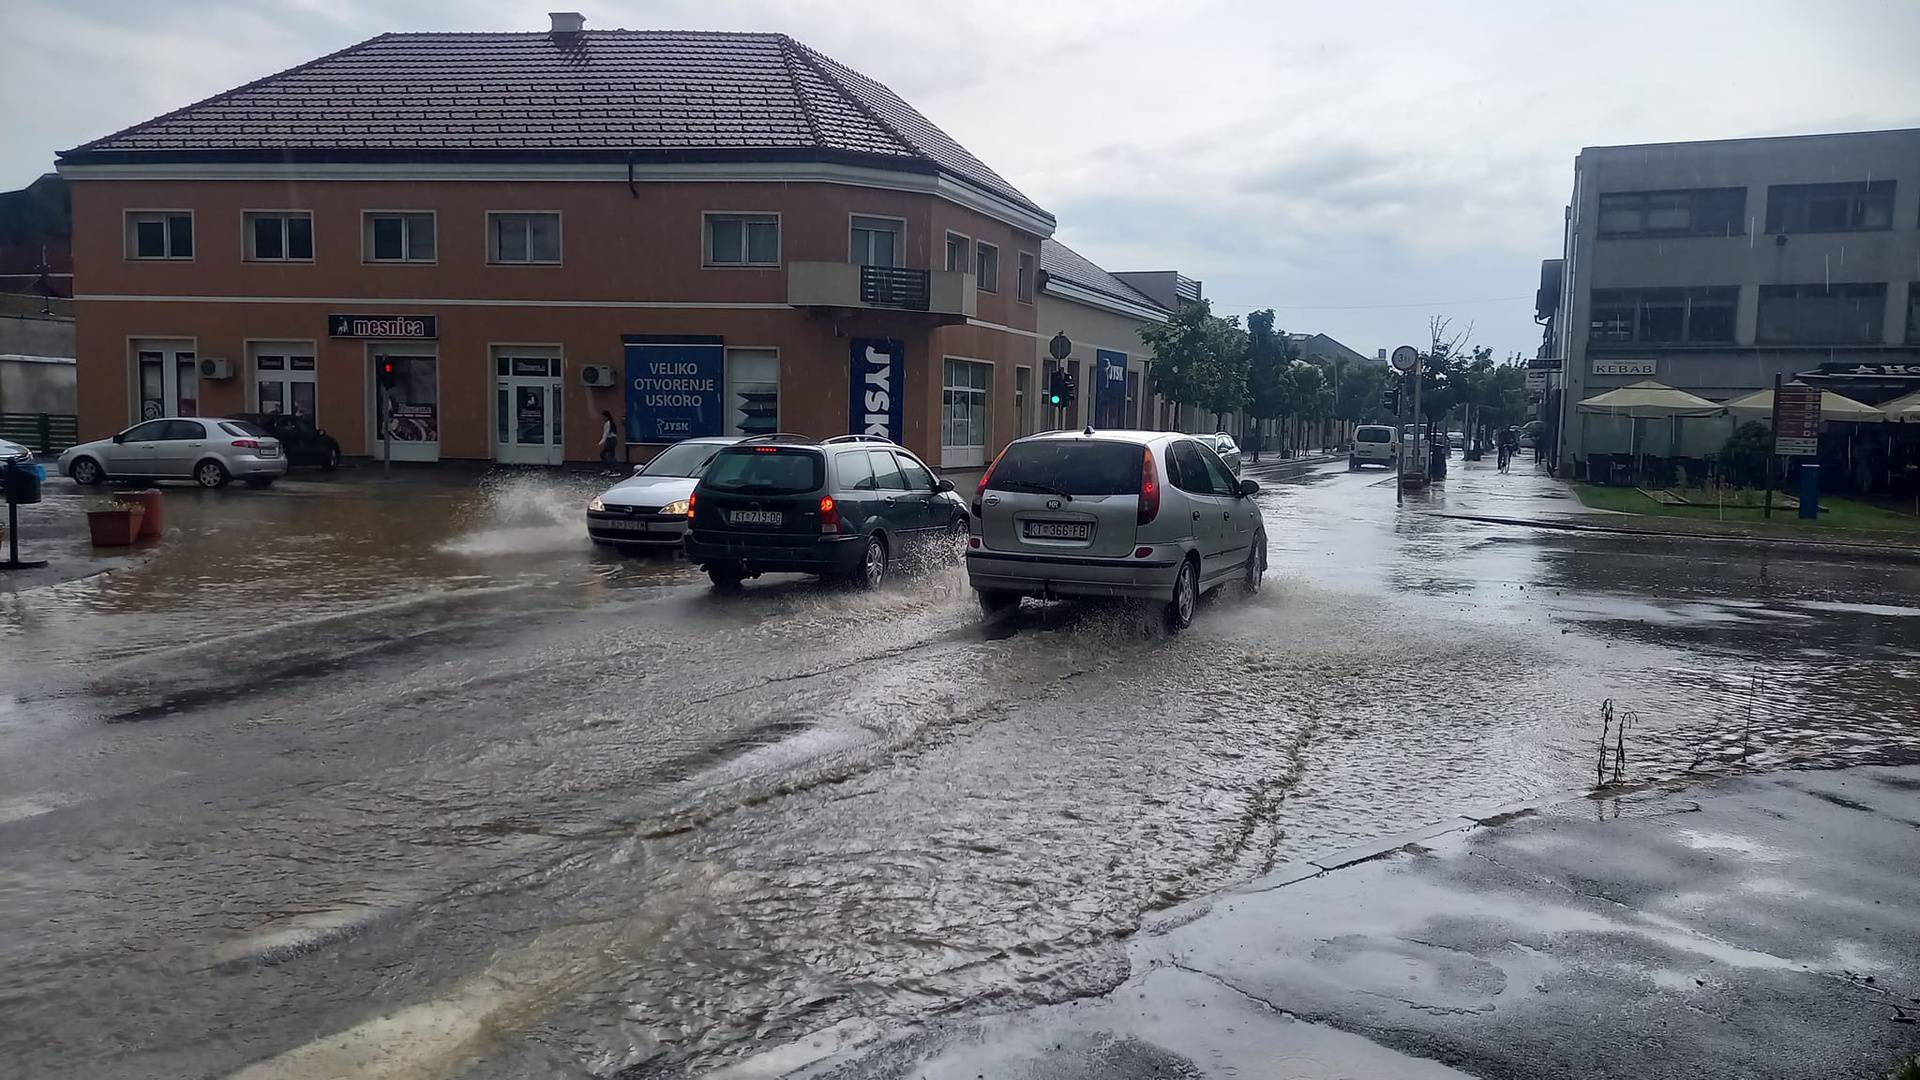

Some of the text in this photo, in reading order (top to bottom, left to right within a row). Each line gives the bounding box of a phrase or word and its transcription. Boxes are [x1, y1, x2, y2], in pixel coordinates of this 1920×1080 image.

[353, 317, 424, 336] mesnica
[649, 362, 698, 375] VELIKO
[1596, 365, 1652, 373] KEBAB
[634, 378, 714, 391] OTVORENJE
[865, 345, 890, 438] JYSK
[645, 394, 703, 408] USKORO
[663, 422, 689, 431] JYSK
[1048, 501, 1060, 509] HR
